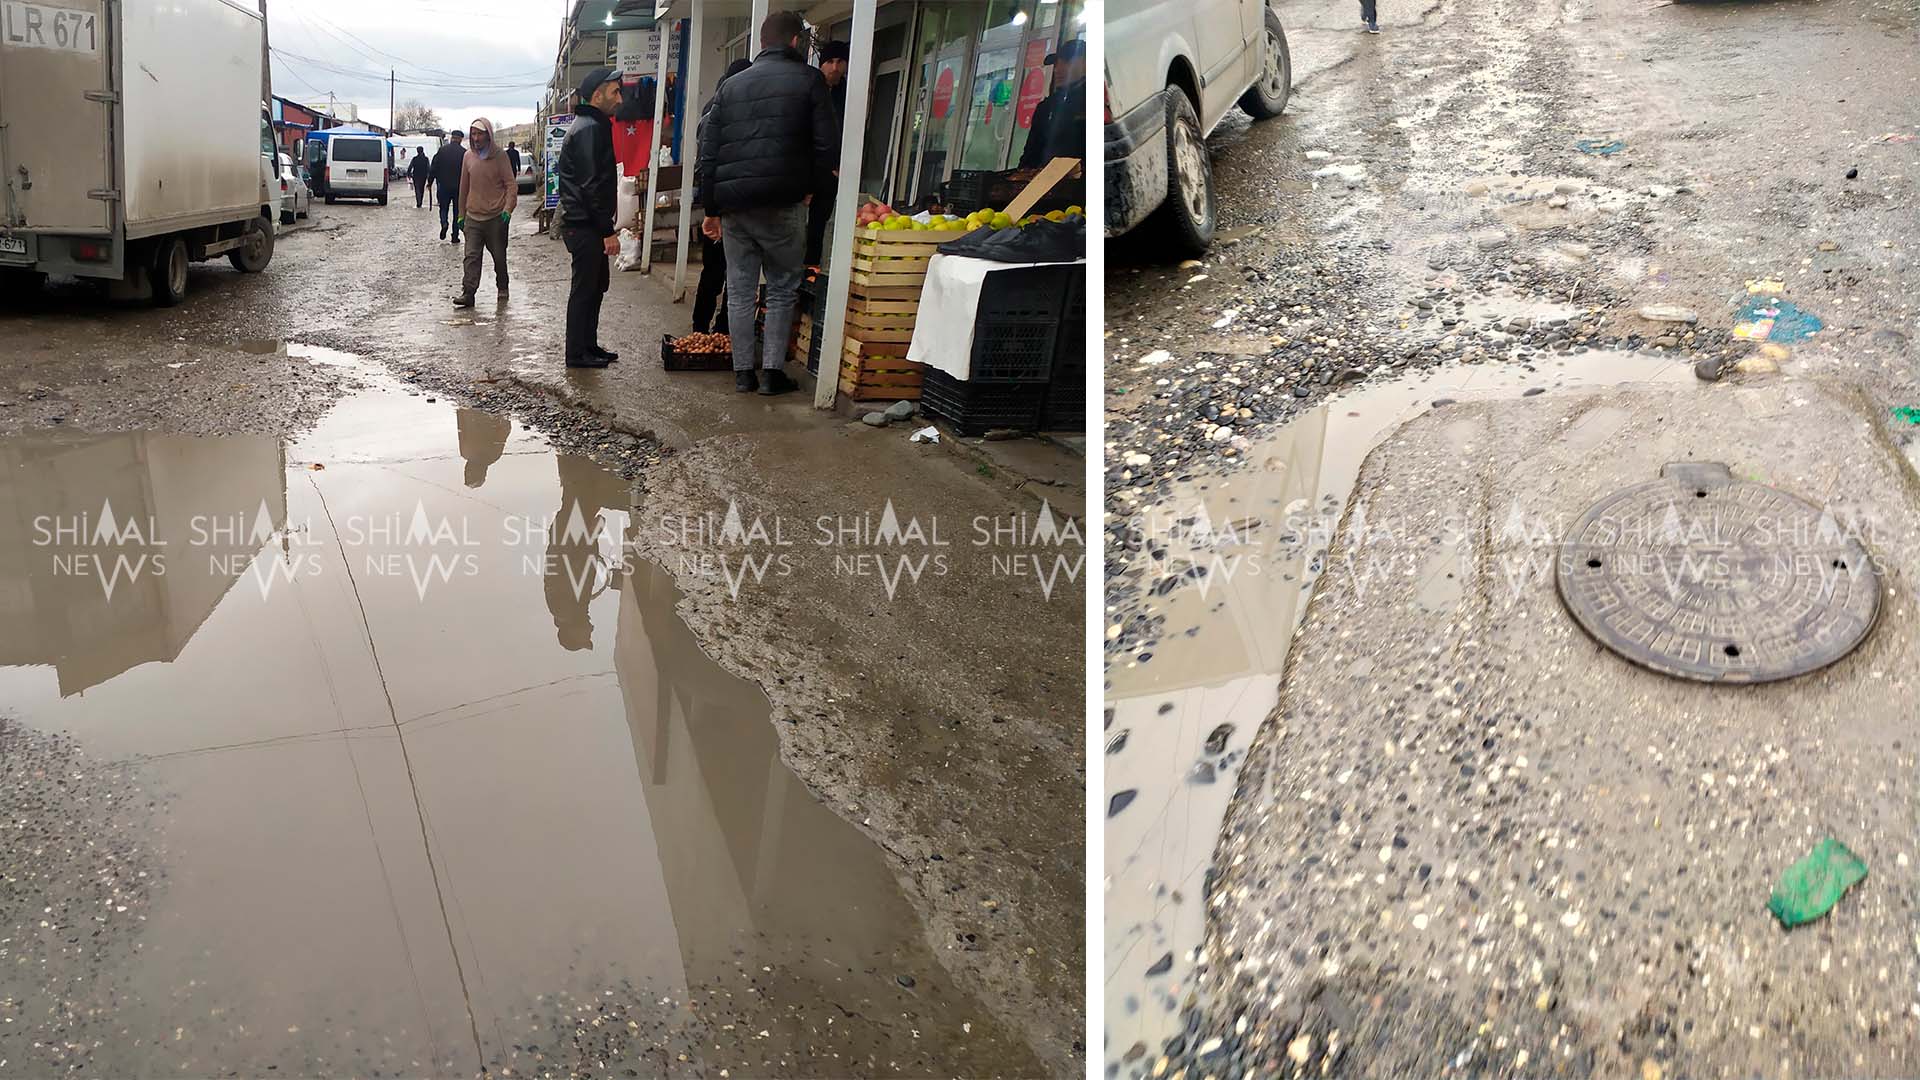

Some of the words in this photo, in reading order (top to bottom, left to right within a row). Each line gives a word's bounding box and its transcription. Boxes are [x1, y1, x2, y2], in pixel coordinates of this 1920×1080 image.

[7, 5, 46, 45] LR
[54, 11, 96, 50] 671
[0, 239, 22, 250] -671
